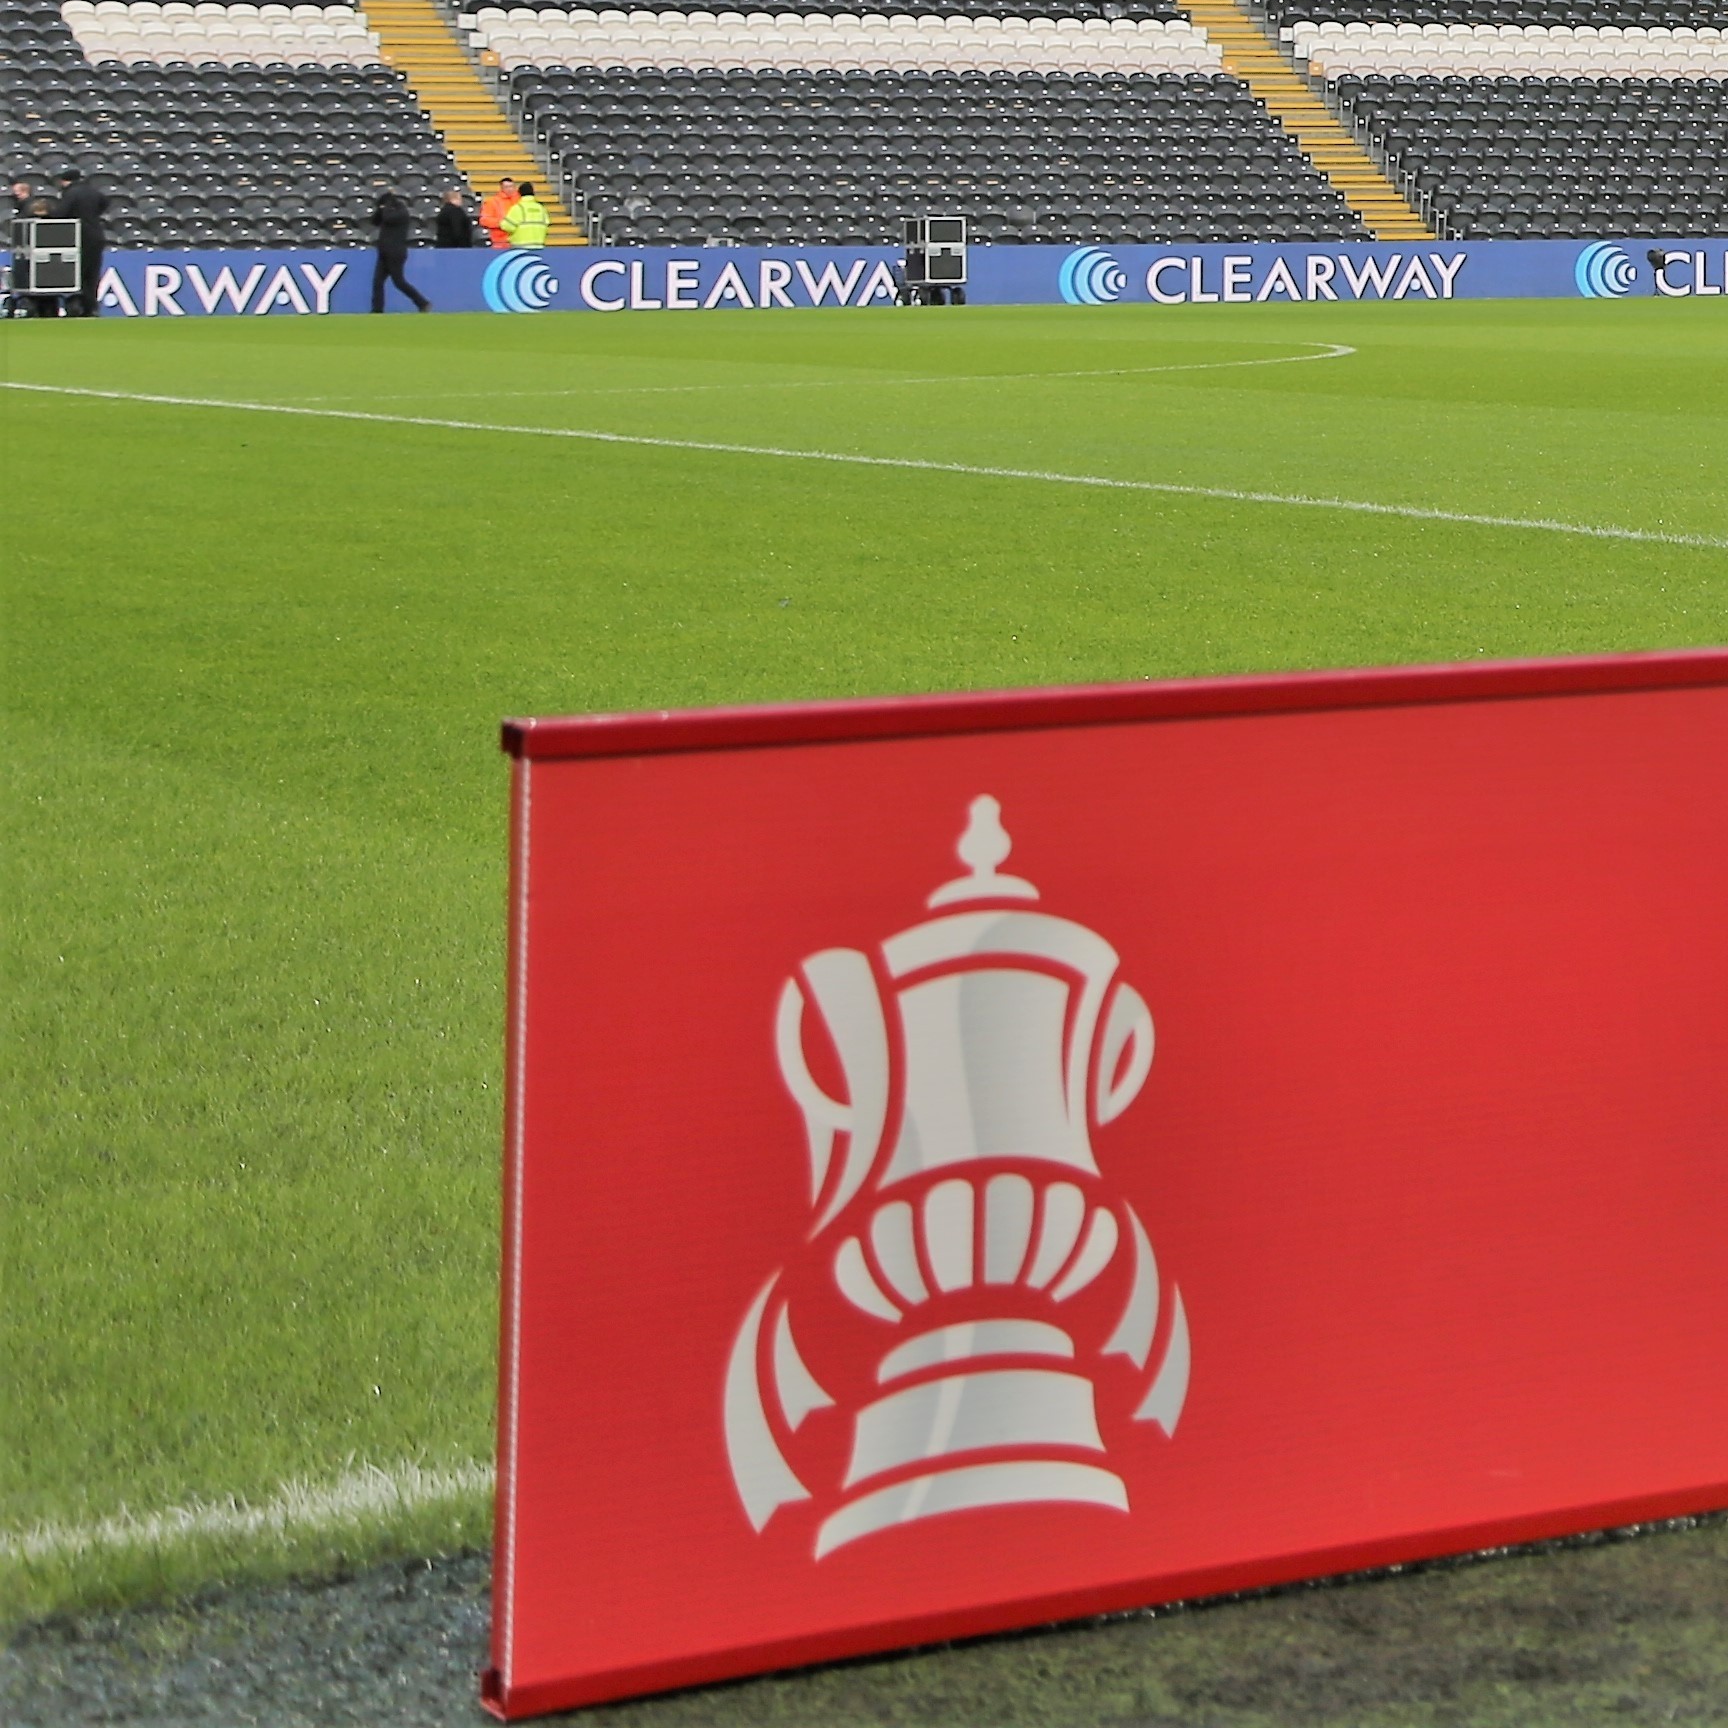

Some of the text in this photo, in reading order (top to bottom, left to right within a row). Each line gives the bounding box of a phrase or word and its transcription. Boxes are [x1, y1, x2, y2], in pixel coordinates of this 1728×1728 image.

[97, 263, 348, 317] ARWAY
[579, 259, 898, 311] CLEARWA
[1145, 253, 1467, 304] CLEARWAY
